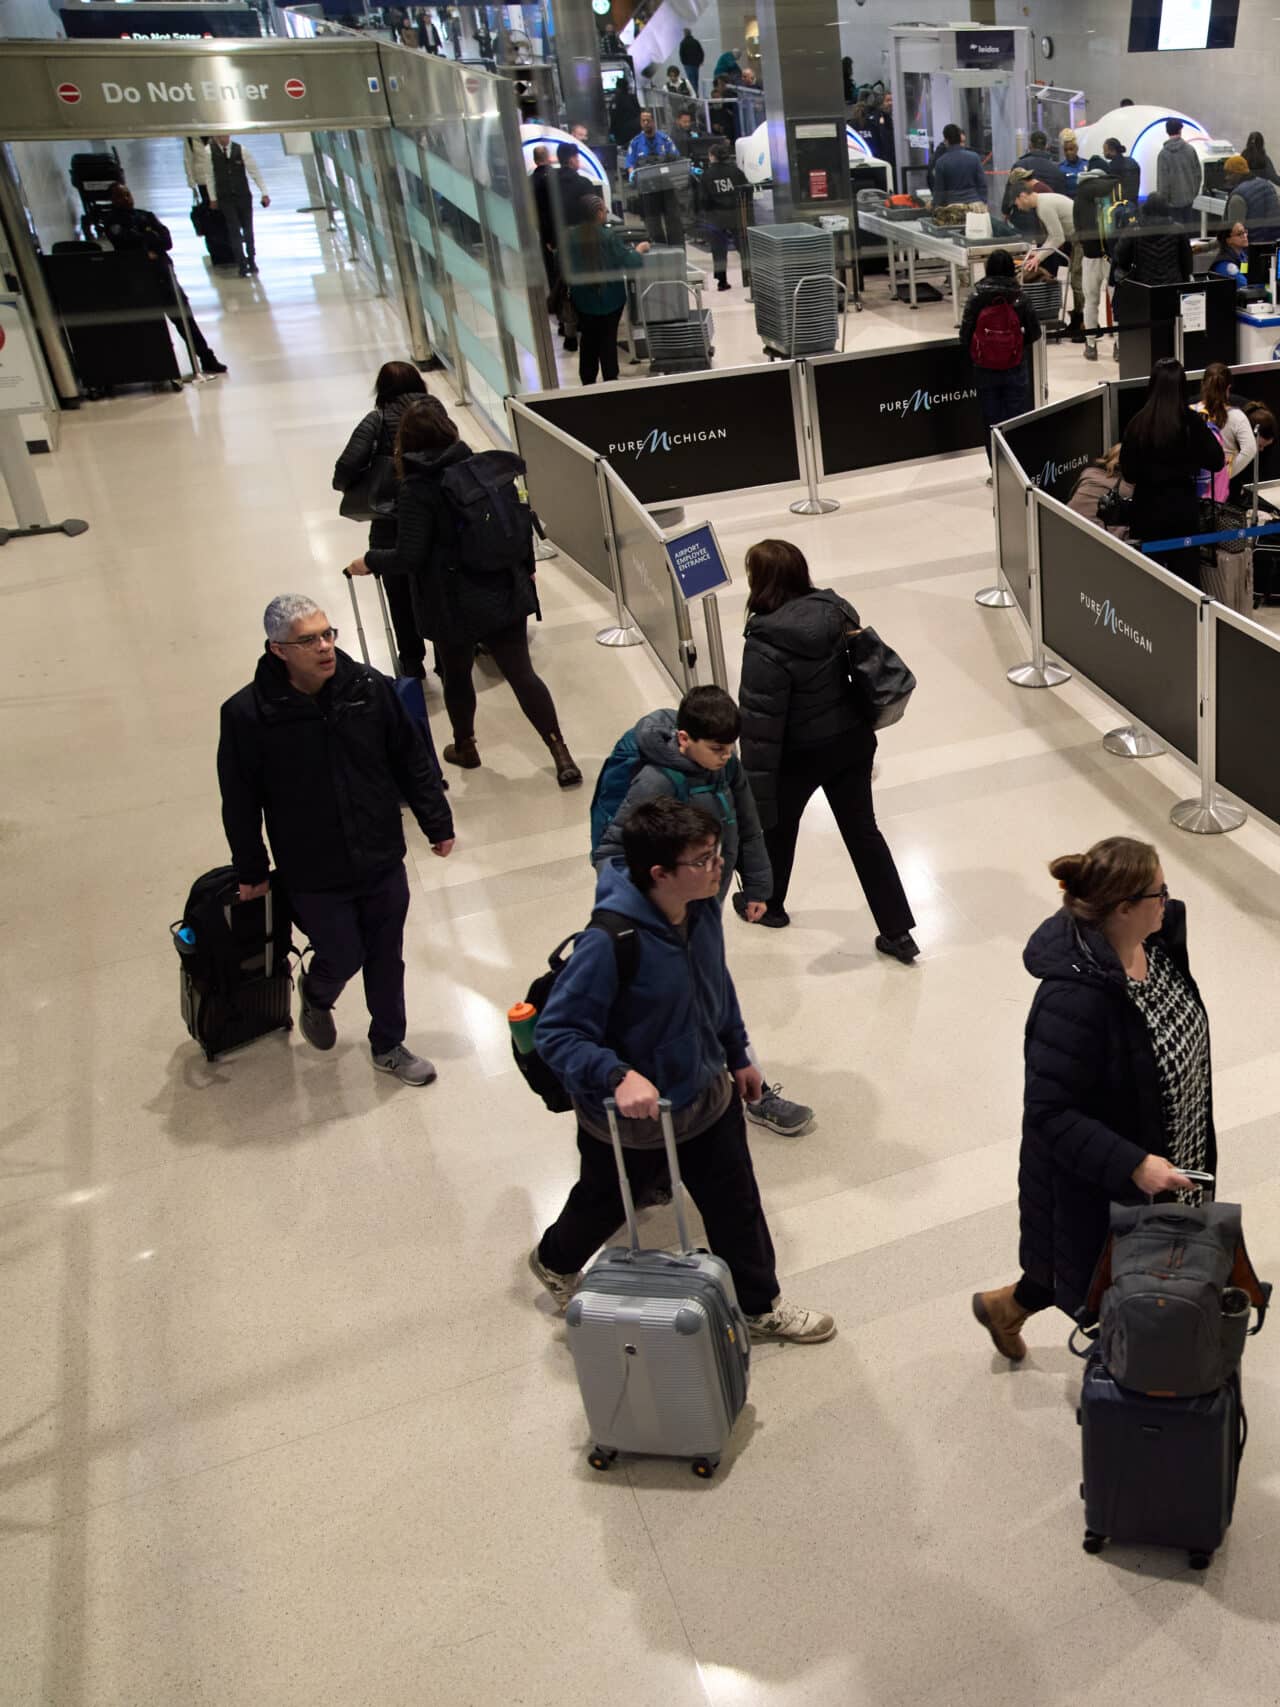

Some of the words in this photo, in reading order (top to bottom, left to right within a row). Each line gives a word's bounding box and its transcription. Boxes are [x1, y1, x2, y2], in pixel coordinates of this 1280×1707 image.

[101, 82, 141, 104] Do
[147, 80, 196, 103] Not
[202, 80, 270, 101] Enter
[714, 177, 734, 193] TSA
[879, 400, 909, 413] PURE
[900, 388, 978, 418] MICHIGAN
[608, 440, 644, 455] PURE
[634, 427, 727, 460] MICHIGAN
[1039, 454, 1089, 488] MICHIGAN
[674, 543, 700, 558] AIRPORT
[676, 547, 708, 566] EMPLOYEE
[679, 553, 711, 572] ENTRANCE
[1080, 592, 1101, 617] PURE
[1094, 599, 1153, 654] MICHIGAN
